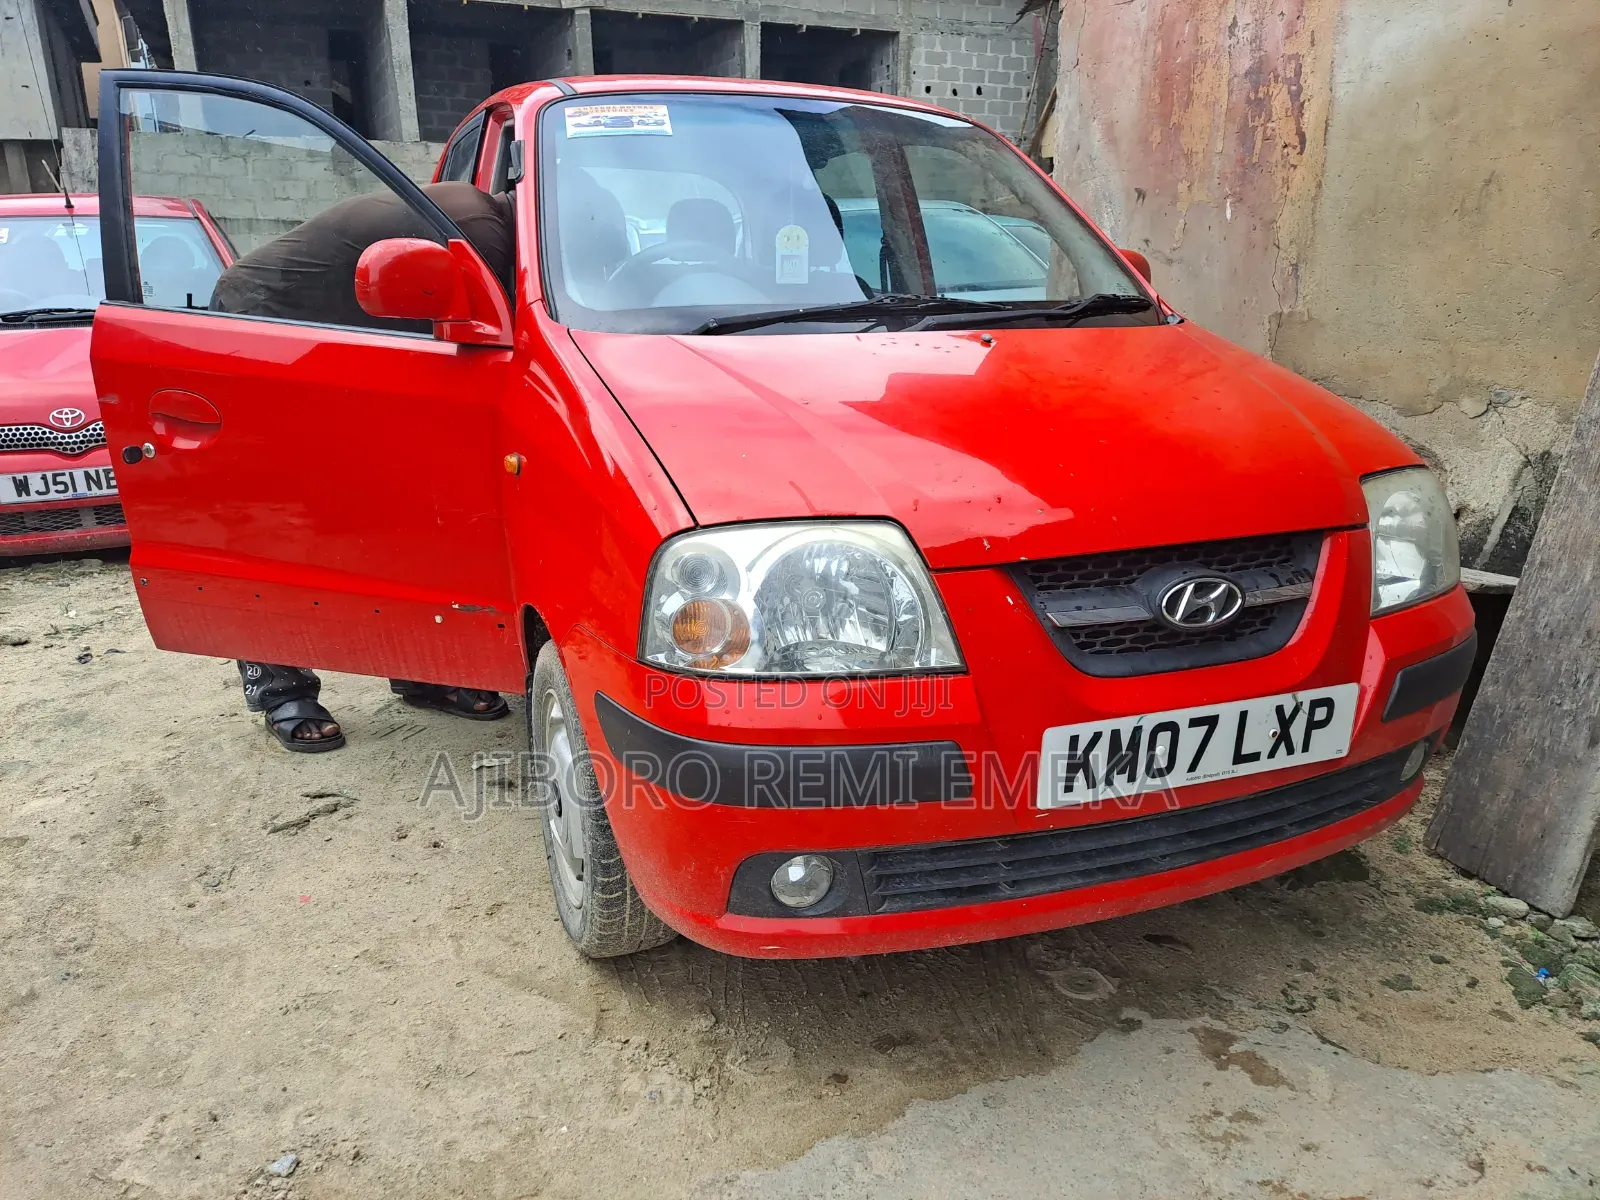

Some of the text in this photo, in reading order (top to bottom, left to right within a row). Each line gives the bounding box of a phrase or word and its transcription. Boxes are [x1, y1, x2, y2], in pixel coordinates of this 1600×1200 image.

[11, 472, 78, 497] WJ51
[245, 684, 257, 696] 21
[1063, 696, 1335, 794] KM07 LXP
